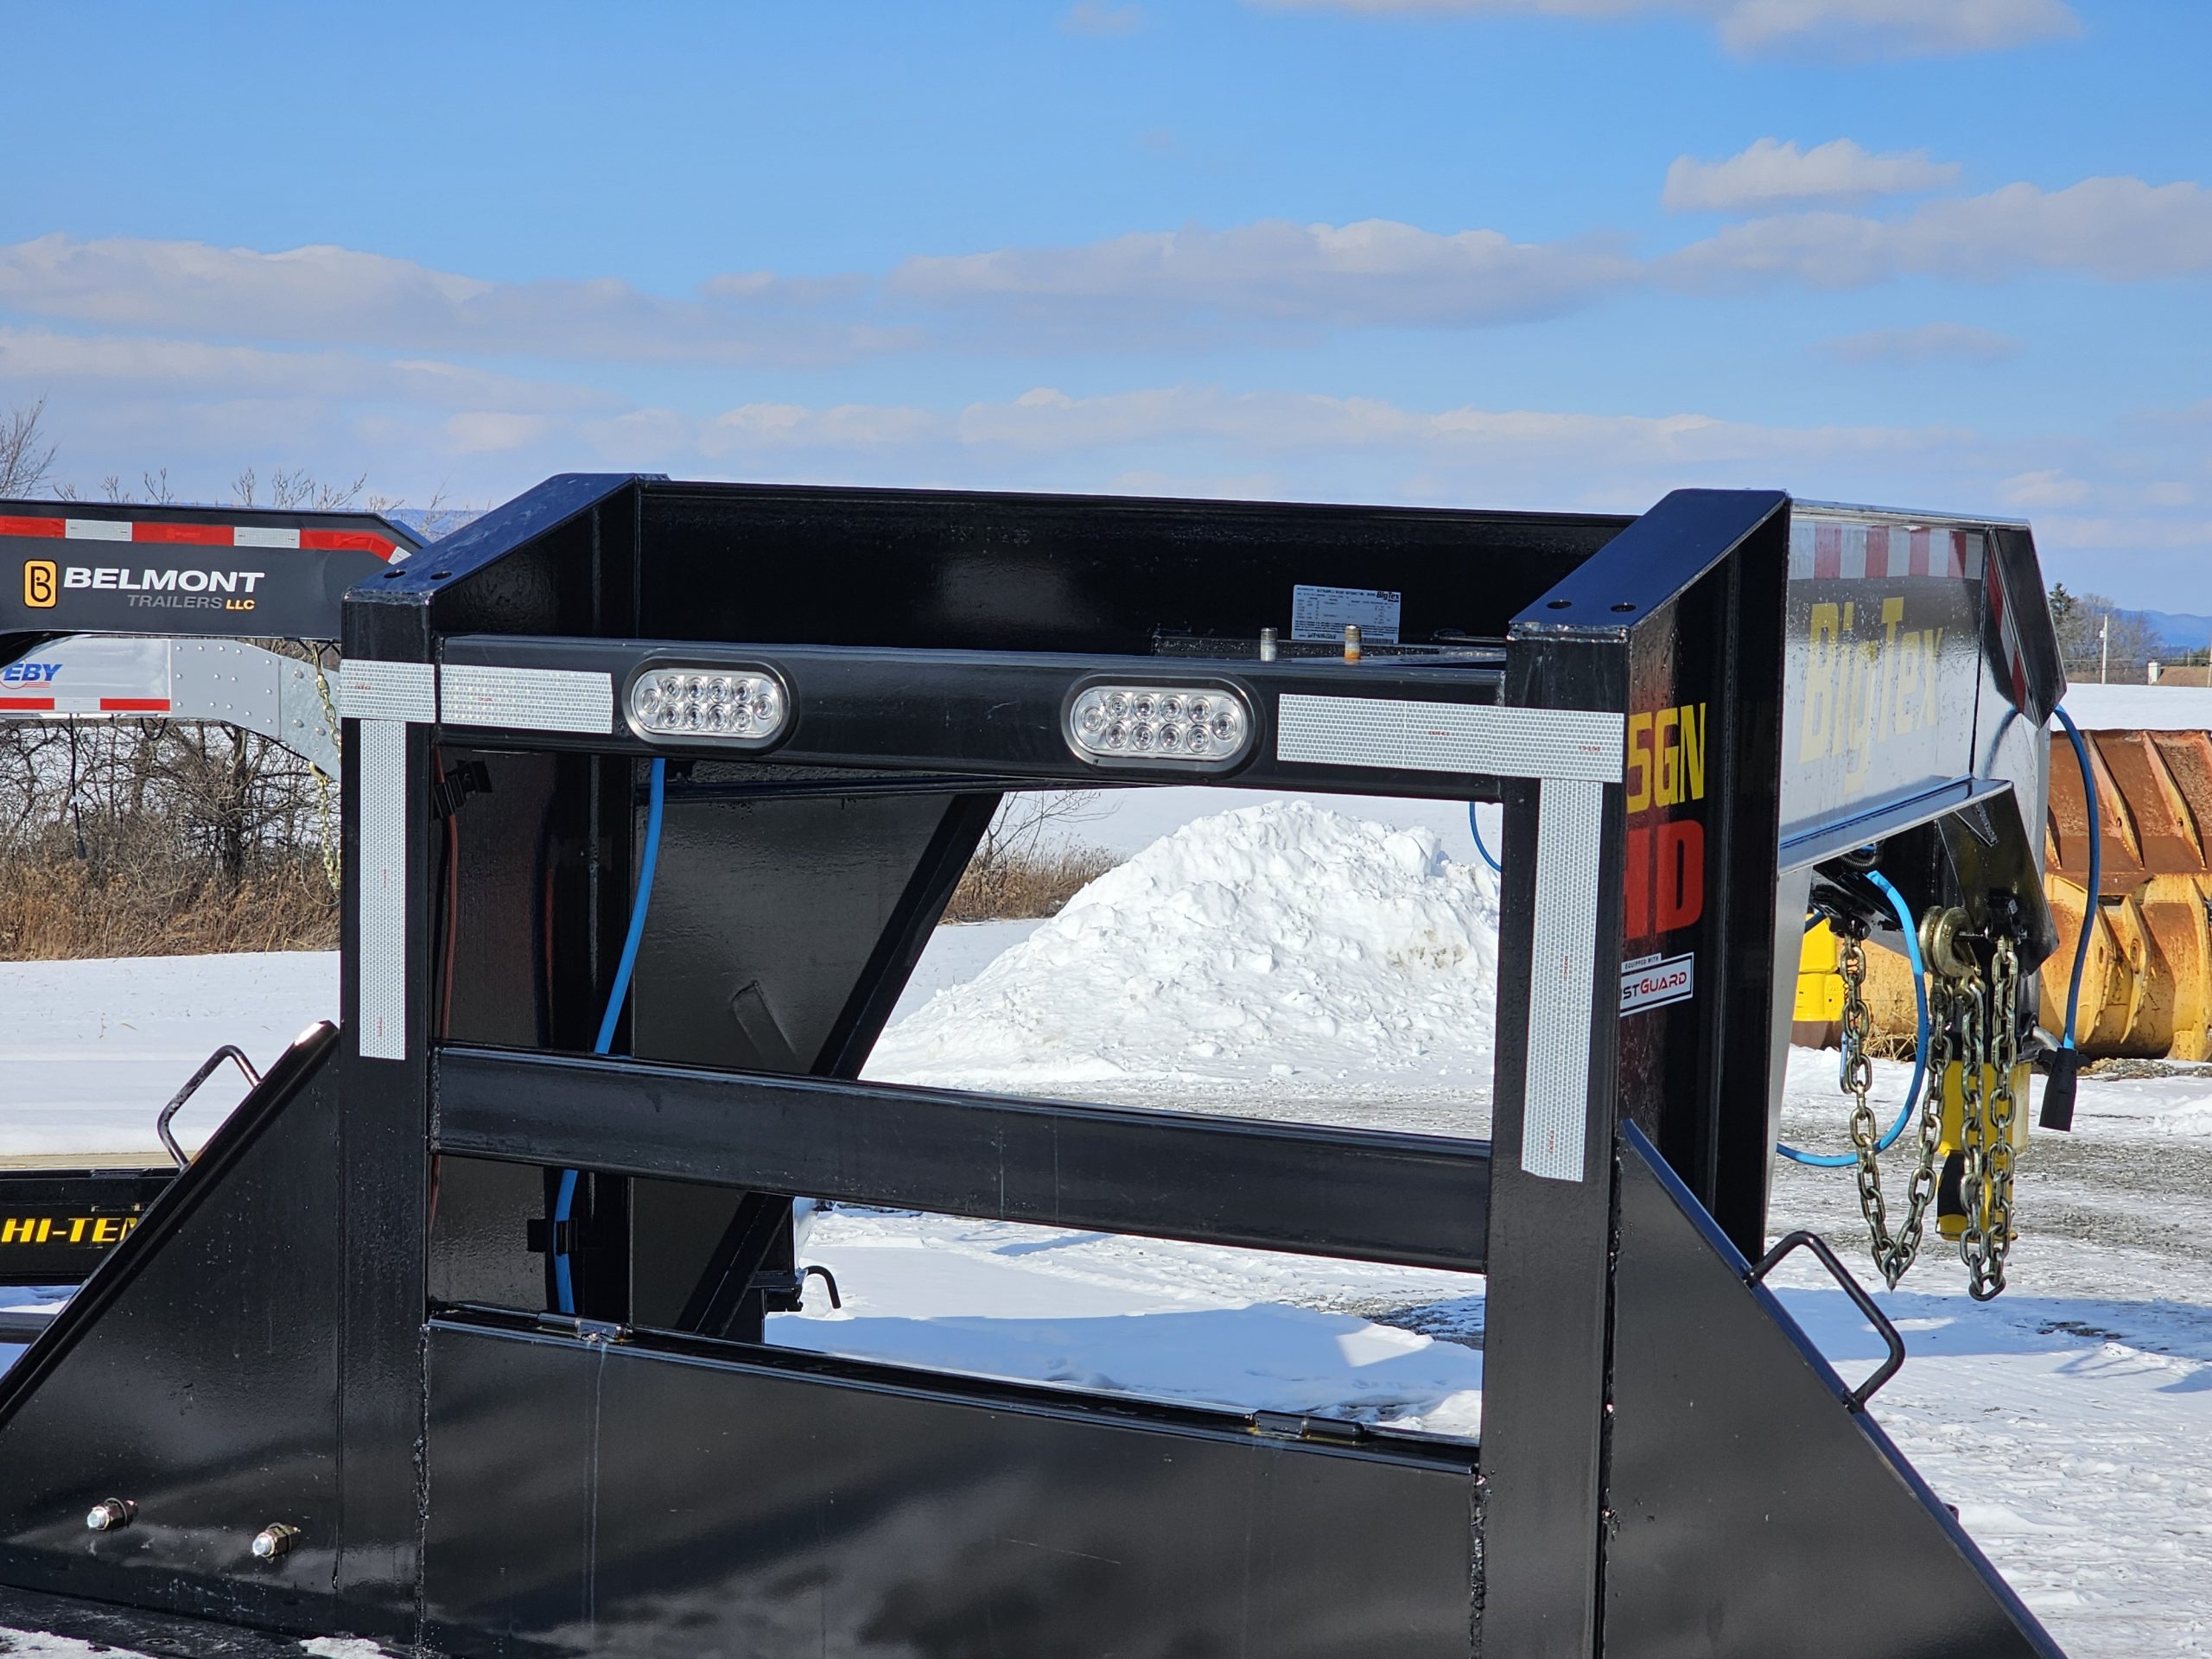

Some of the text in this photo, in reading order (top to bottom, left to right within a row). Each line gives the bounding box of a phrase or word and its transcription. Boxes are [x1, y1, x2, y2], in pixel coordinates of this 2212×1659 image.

[64, 567, 264, 593] BELMONT
[128, 594, 255, 610] TRAILERS LLC
[3, 664, 62, 681] EBY
[1625, 956, 1659, 969] EQUIPPED WITH
[2, 1218, 138, 1243] HI-TE
